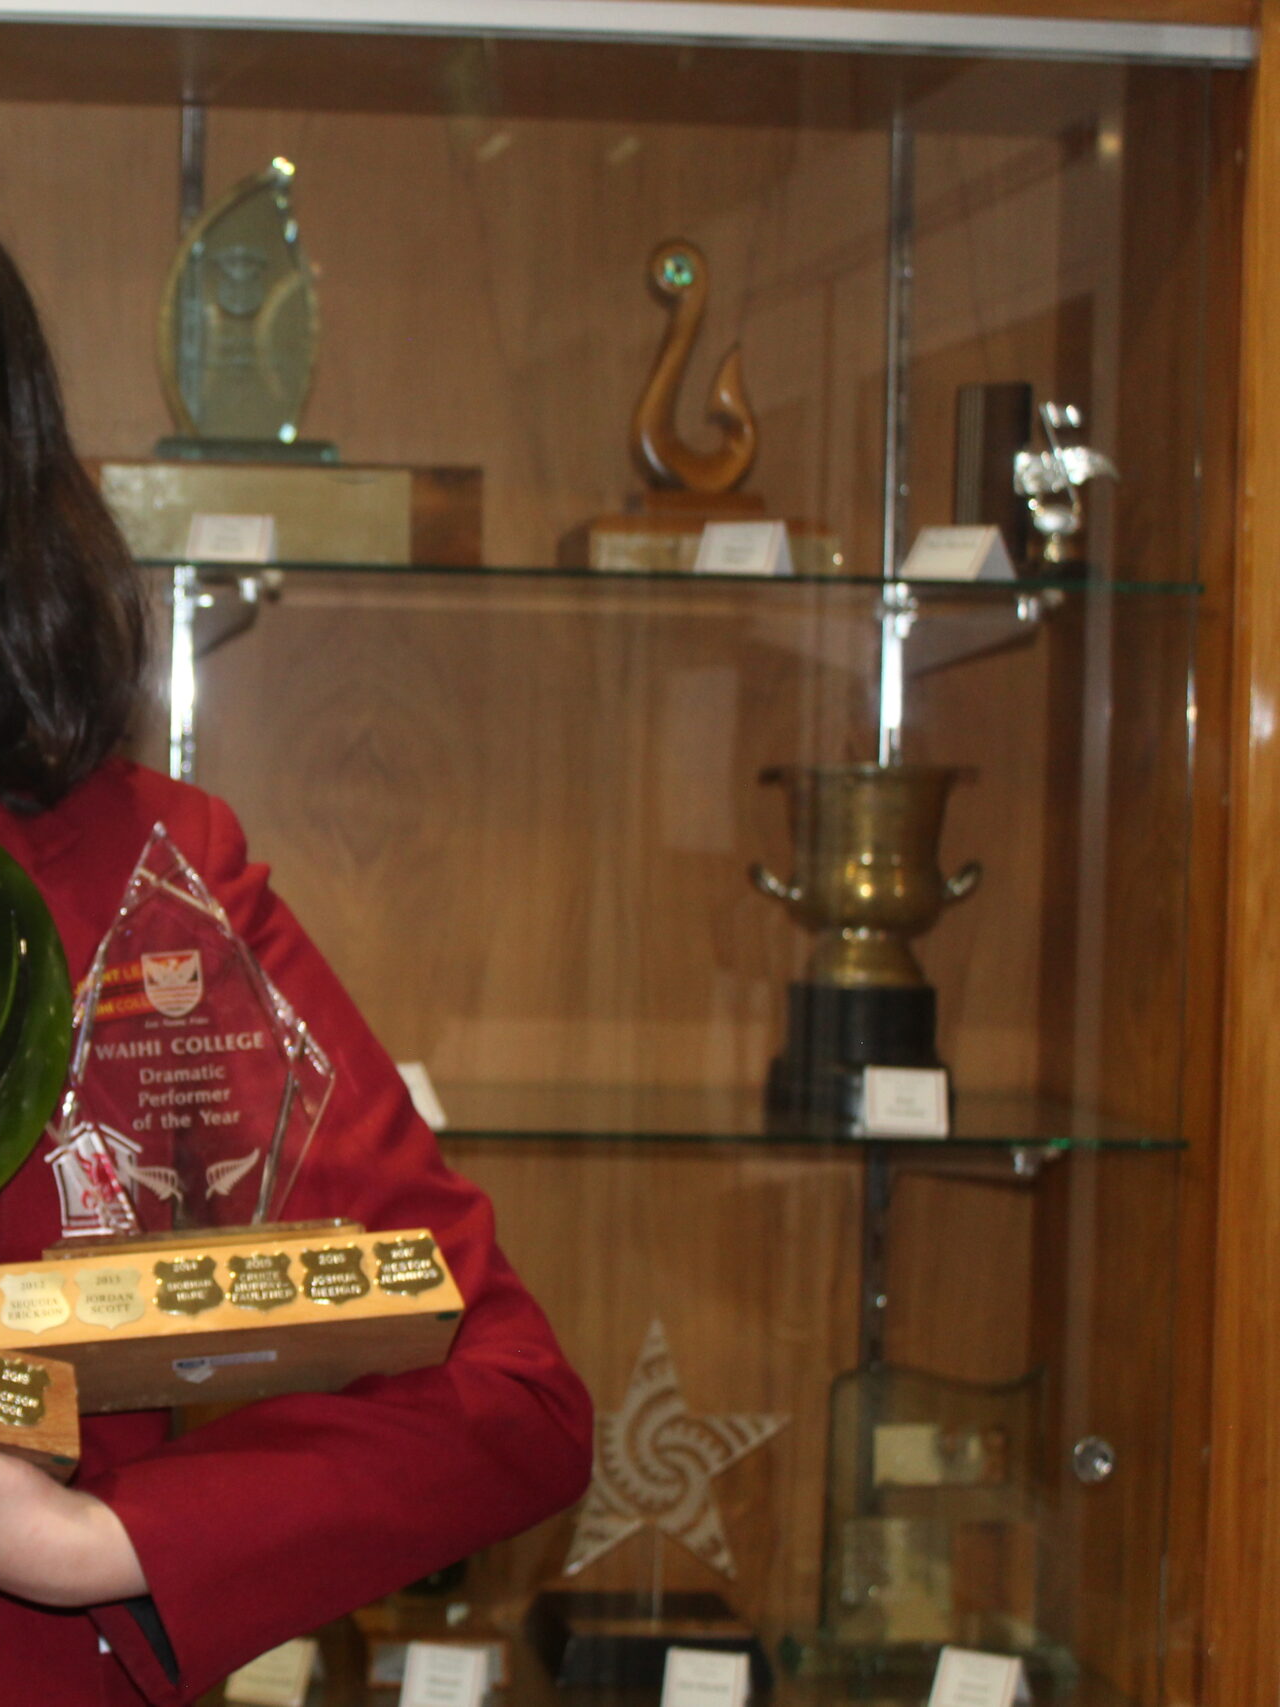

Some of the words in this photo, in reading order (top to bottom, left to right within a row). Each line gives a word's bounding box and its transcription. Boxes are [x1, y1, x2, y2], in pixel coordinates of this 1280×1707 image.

[95, 1040, 162, 1061] WAIHI
[171, 1032, 264, 1055] COLLEGE
[139, 1064, 225, 1085] Dramatic
[138, 1088, 231, 1107] Performer
[132, 1113, 152, 1131] of
[161, 1112, 191, 1129] the
[200, 1109, 240, 1126] Year
[381, 1259, 431, 1273] WESTON
[21, 1280, 45, 1291] 2012
[96, 1275, 120, 1286] 2013
[312, 1273, 357, 1286] JOSHUA
[11, 1297, 58, 1310] SEQUOIA
[85, 1292, 133, 1304] JORDAN
[8, 1307, 64, 1321] ERICKSON
[90, 1303, 131, 1314] SCOTT
